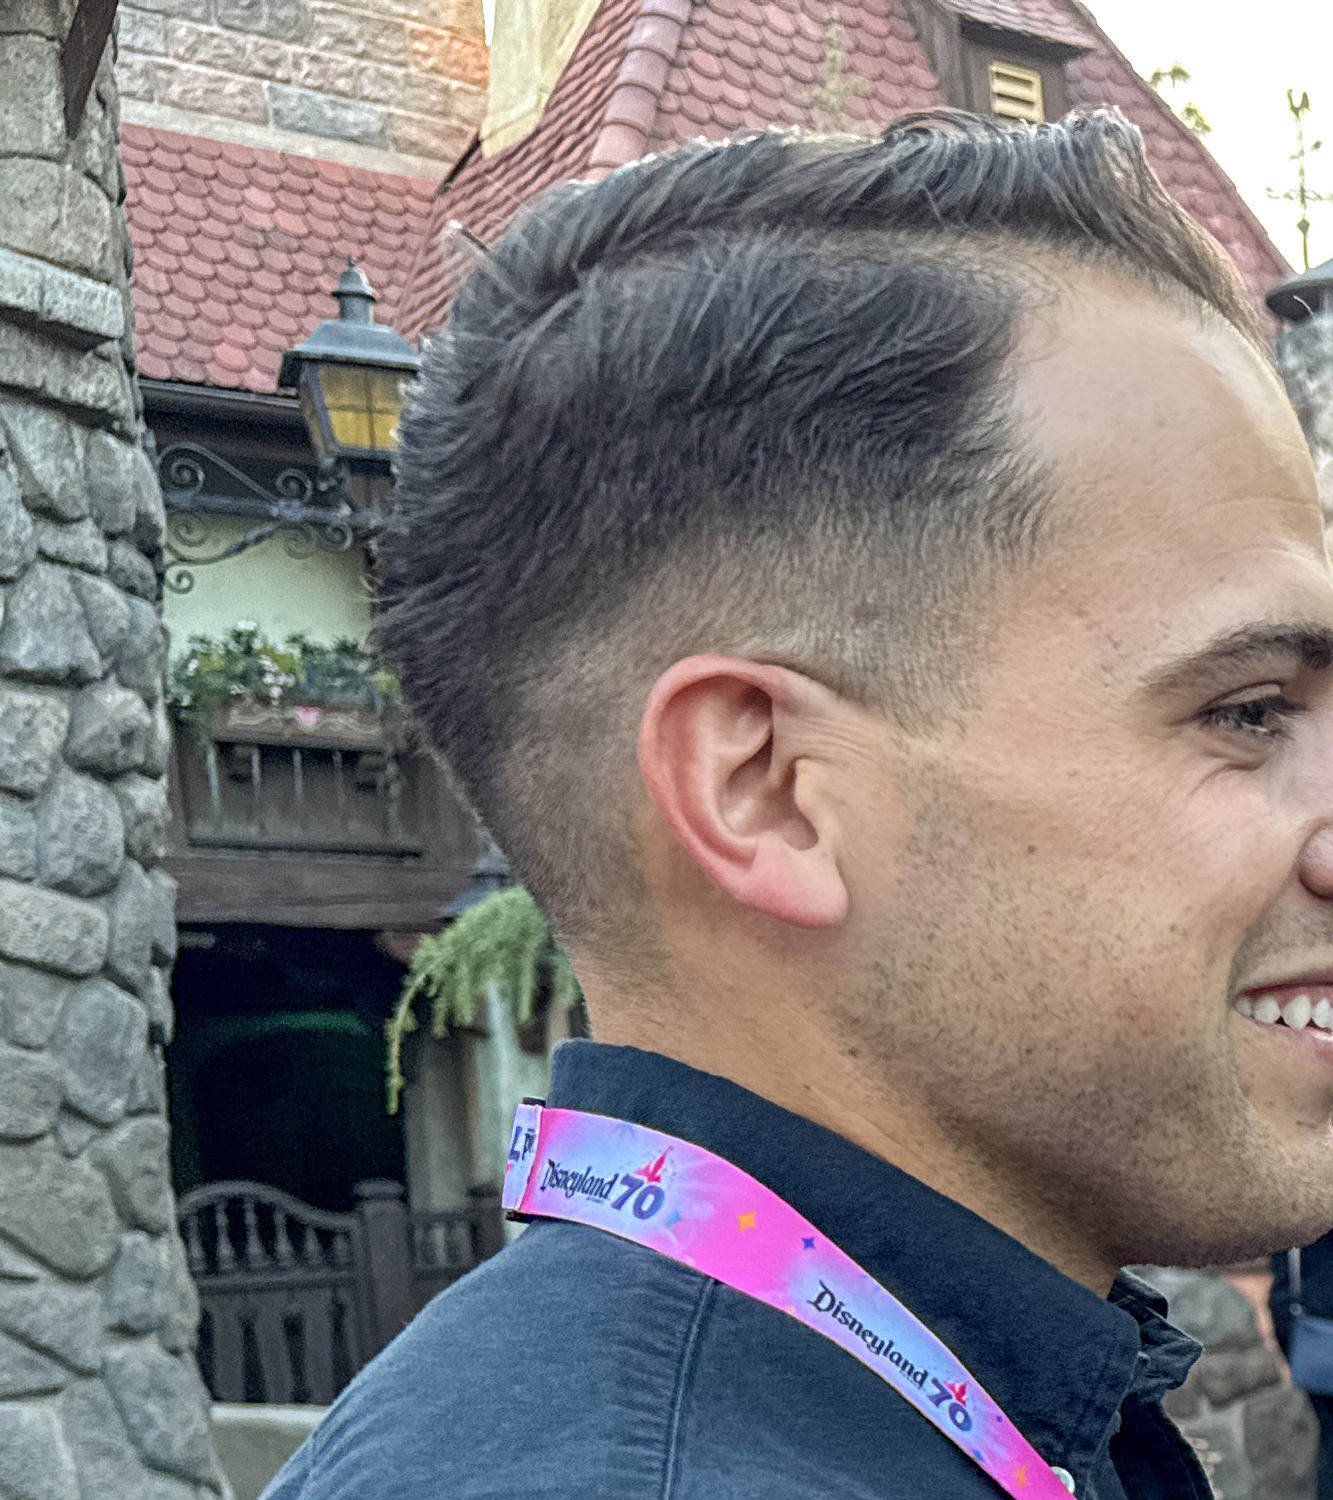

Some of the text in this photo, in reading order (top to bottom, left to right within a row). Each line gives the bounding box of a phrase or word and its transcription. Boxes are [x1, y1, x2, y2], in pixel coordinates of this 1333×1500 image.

[540, 1159, 665, 1220] Disneyland 70
[806, 1280, 973, 1431] Disneyland 70
